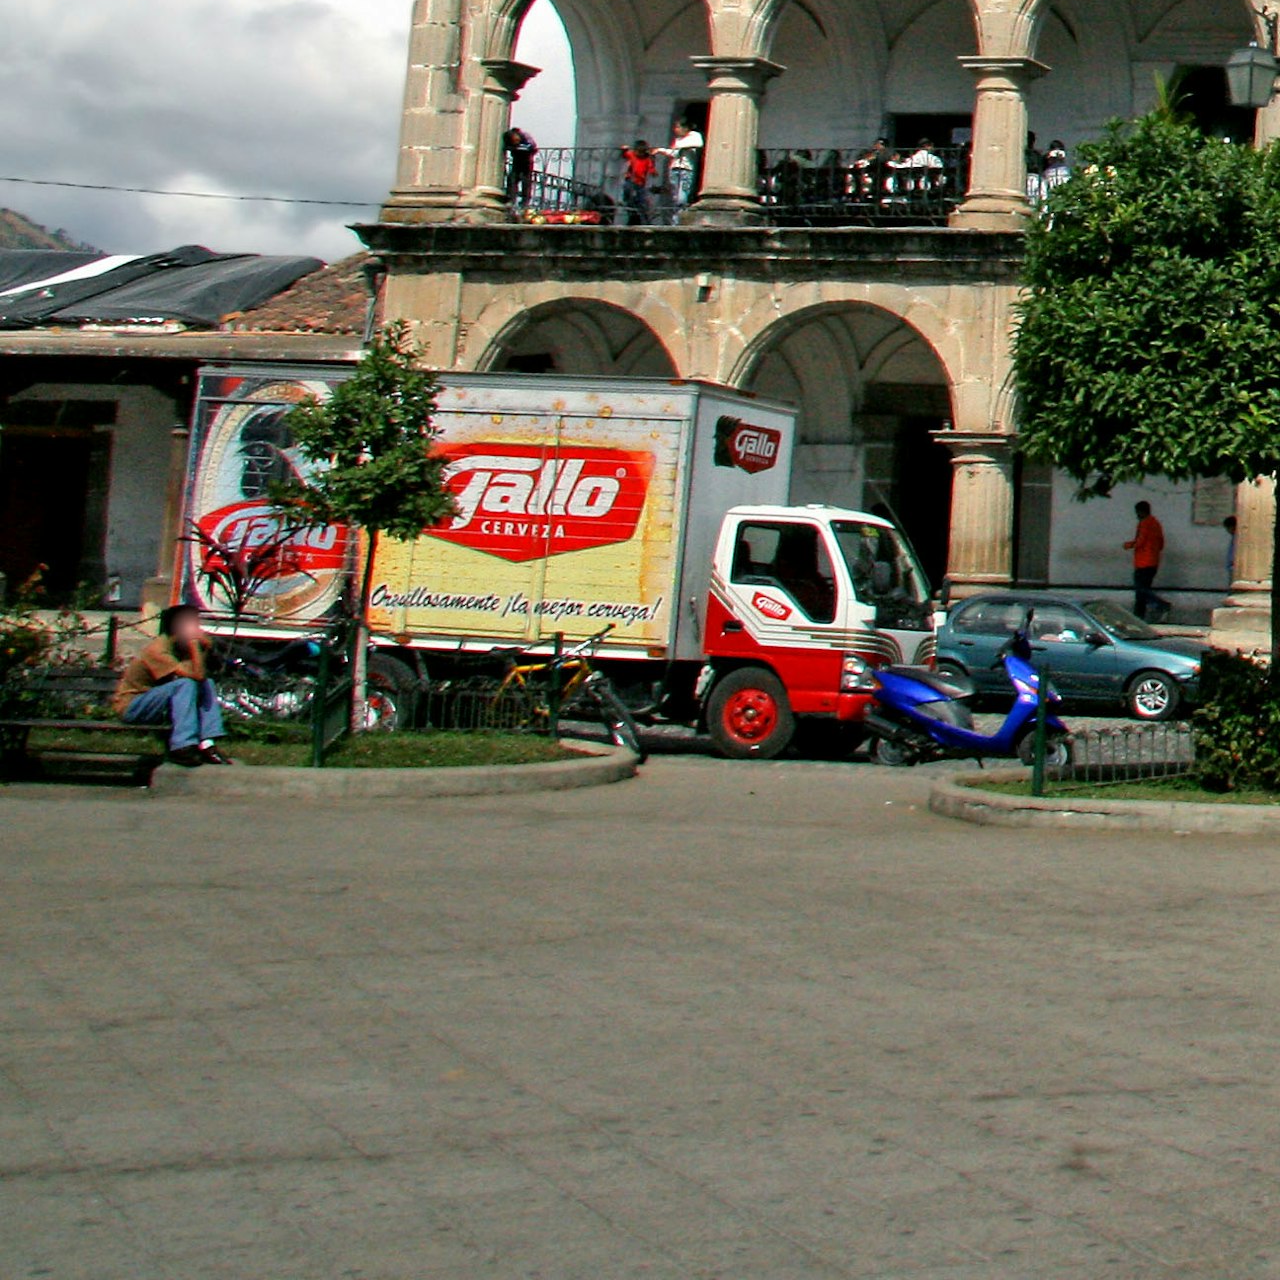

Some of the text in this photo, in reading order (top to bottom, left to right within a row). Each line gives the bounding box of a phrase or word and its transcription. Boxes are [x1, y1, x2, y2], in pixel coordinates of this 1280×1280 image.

[735, 429, 776, 460] Gallo
[441, 455, 621, 531] Gallo
[481, 521, 566, 539] CERVEZA
[371, 584, 501, 615] Orgullosamente
[533, 597, 585, 622] mejor
[588, 596, 663, 626] cerveza!
[756, 596, 787, 617] Gallo
